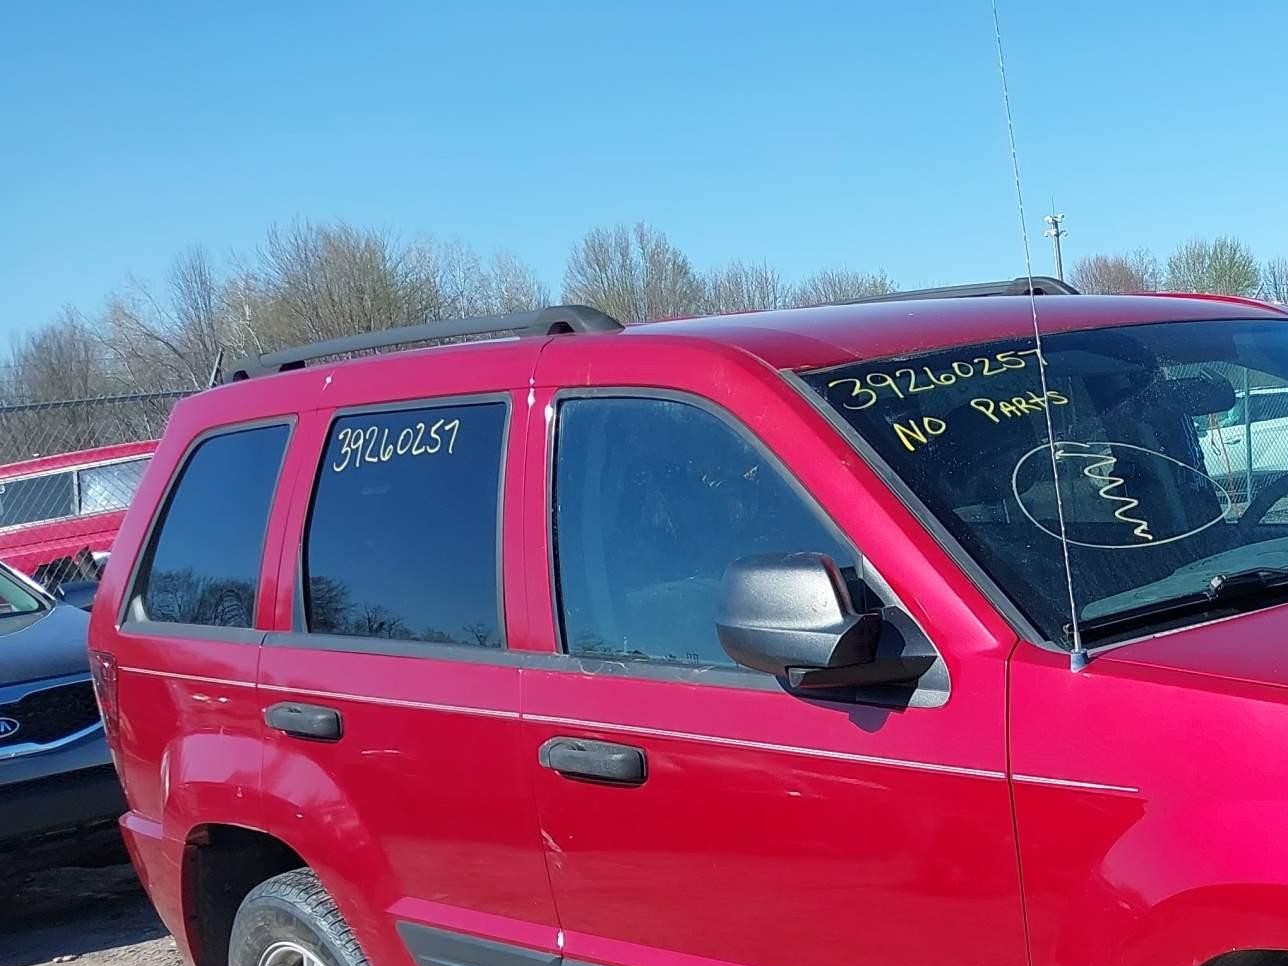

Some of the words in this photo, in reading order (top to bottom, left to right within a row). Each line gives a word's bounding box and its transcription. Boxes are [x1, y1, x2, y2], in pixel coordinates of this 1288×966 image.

[828, 348, 1048, 410] 39260257
[333, 418, 460, 472] 39260257
[893, 416, 946, 452] NO
